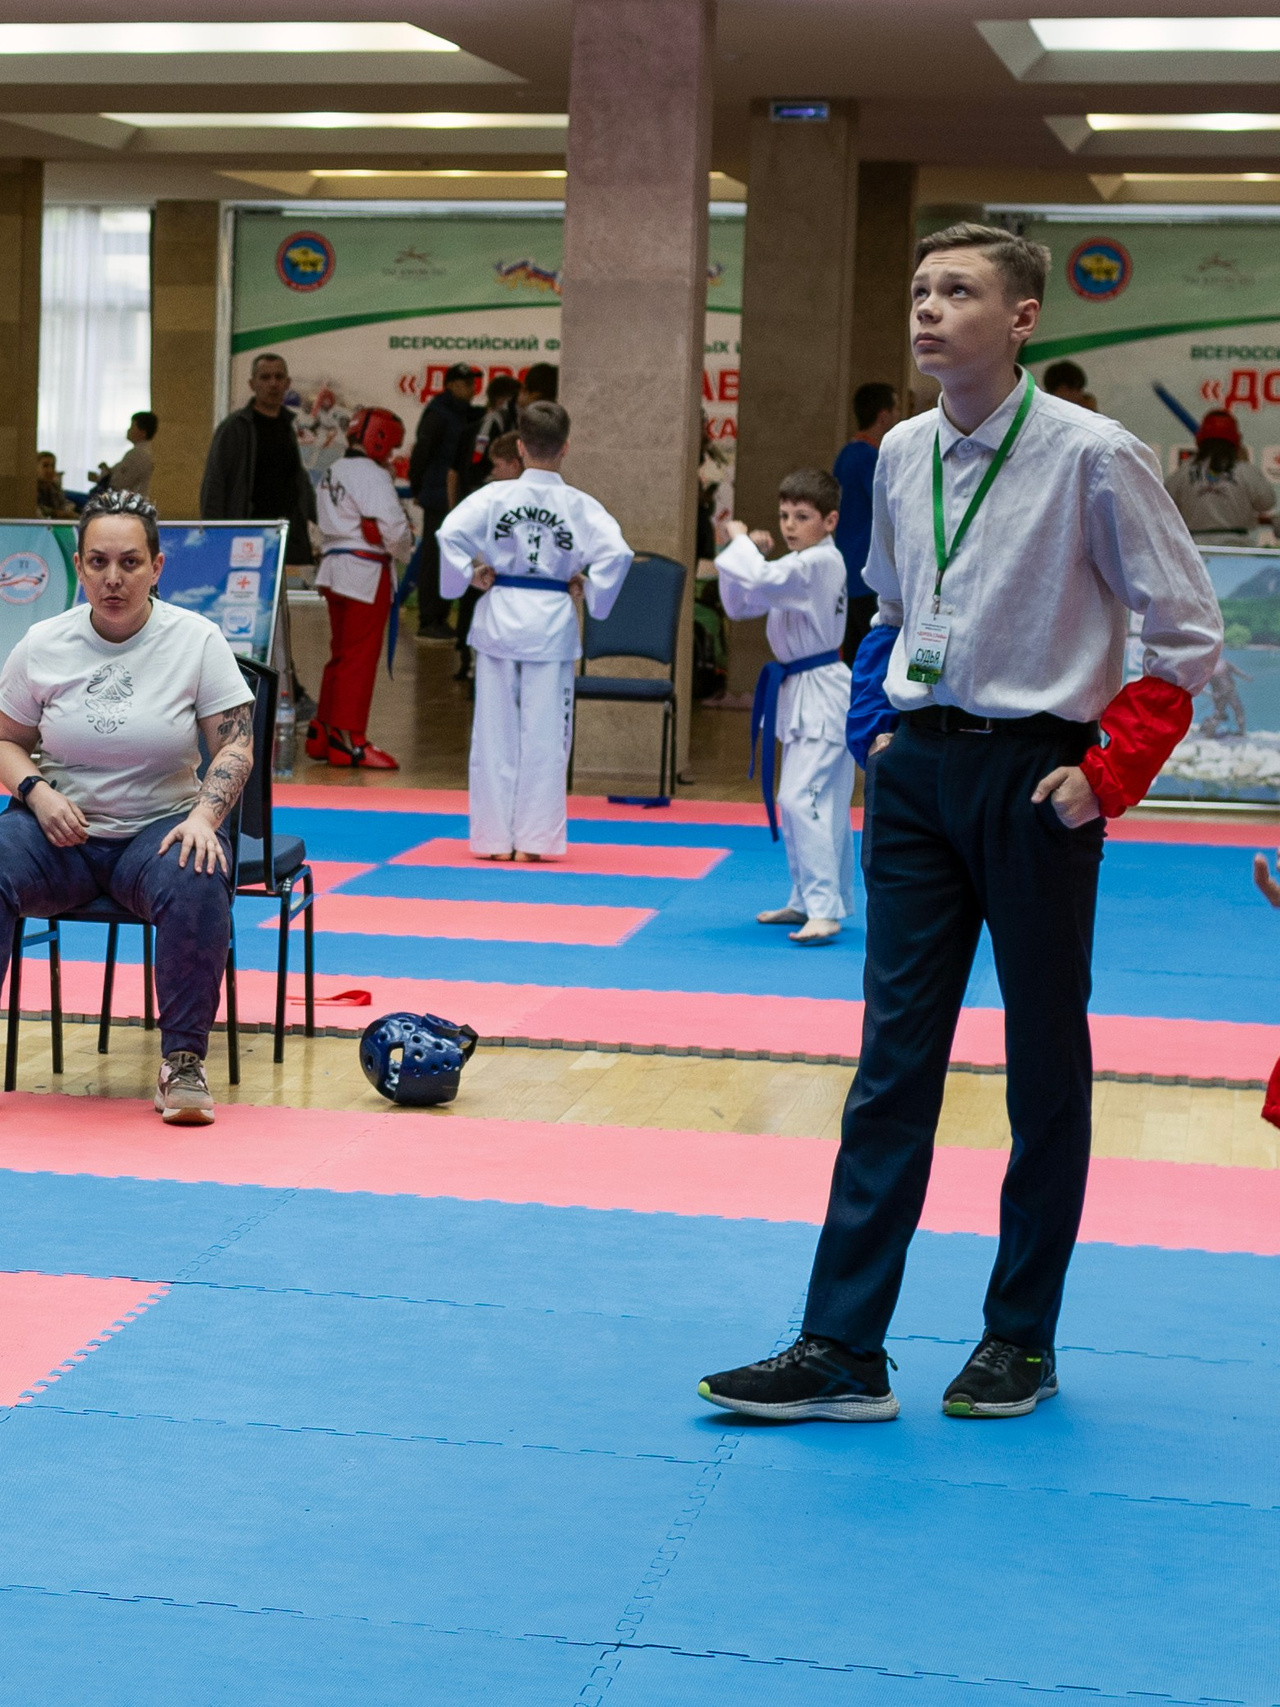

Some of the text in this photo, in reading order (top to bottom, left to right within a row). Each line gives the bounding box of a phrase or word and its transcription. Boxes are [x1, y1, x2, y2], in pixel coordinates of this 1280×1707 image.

[389, 334, 539, 350] ВСЕРОССИЙСКИЙ
[1190, 345, 1280, 359] ВСЕРОСС
[1200, 369, 1280, 411] «ДО
[915, 648, 941, 664] СУДЬЯ
